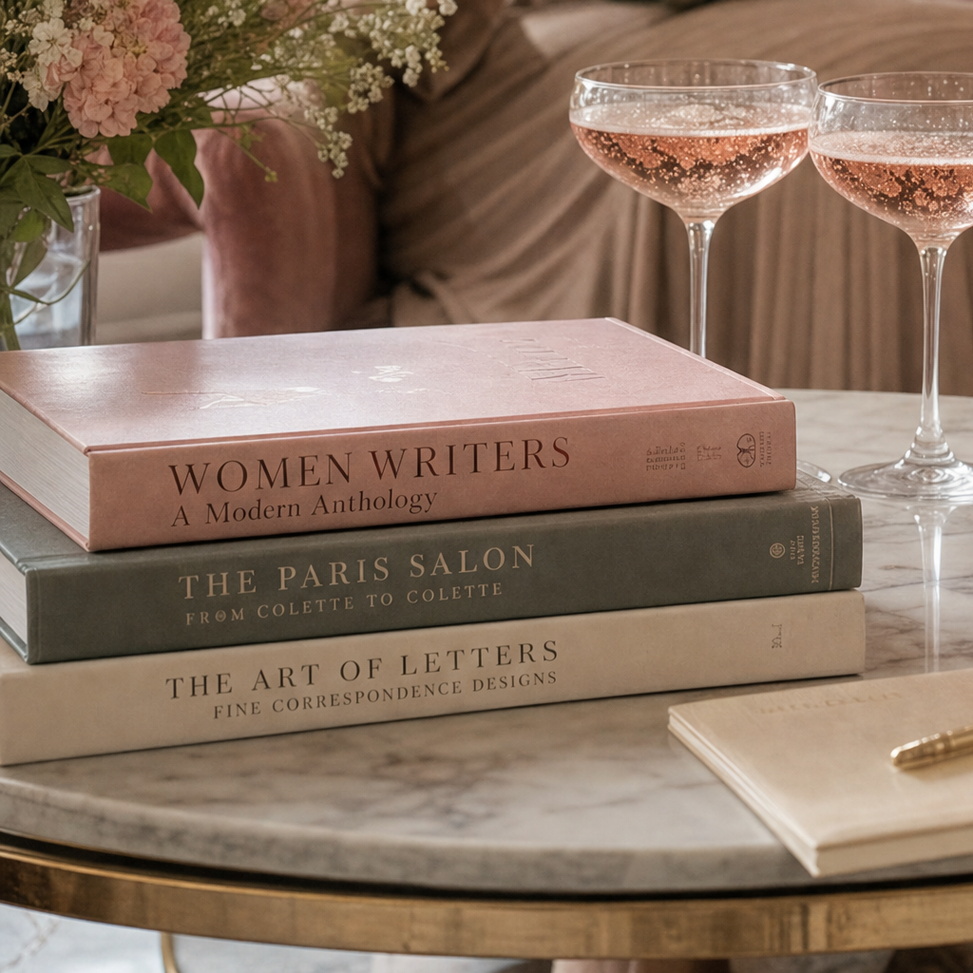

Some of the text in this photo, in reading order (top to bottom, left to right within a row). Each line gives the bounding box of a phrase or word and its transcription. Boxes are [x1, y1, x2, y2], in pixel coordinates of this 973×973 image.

[169, 436, 570, 496] WOMEN WRITERS
[171, 489, 438, 527] A Modern Anthology
[179, 544, 535, 600] THE PARIS SALON
[185, 582, 503, 626] FROM COLETTE TO COLETTE
[166, 640, 559, 700] THE ART OF LETTERS
[213, 671, 558, 719] FINE CORRESPONDENCE DESIGNS
